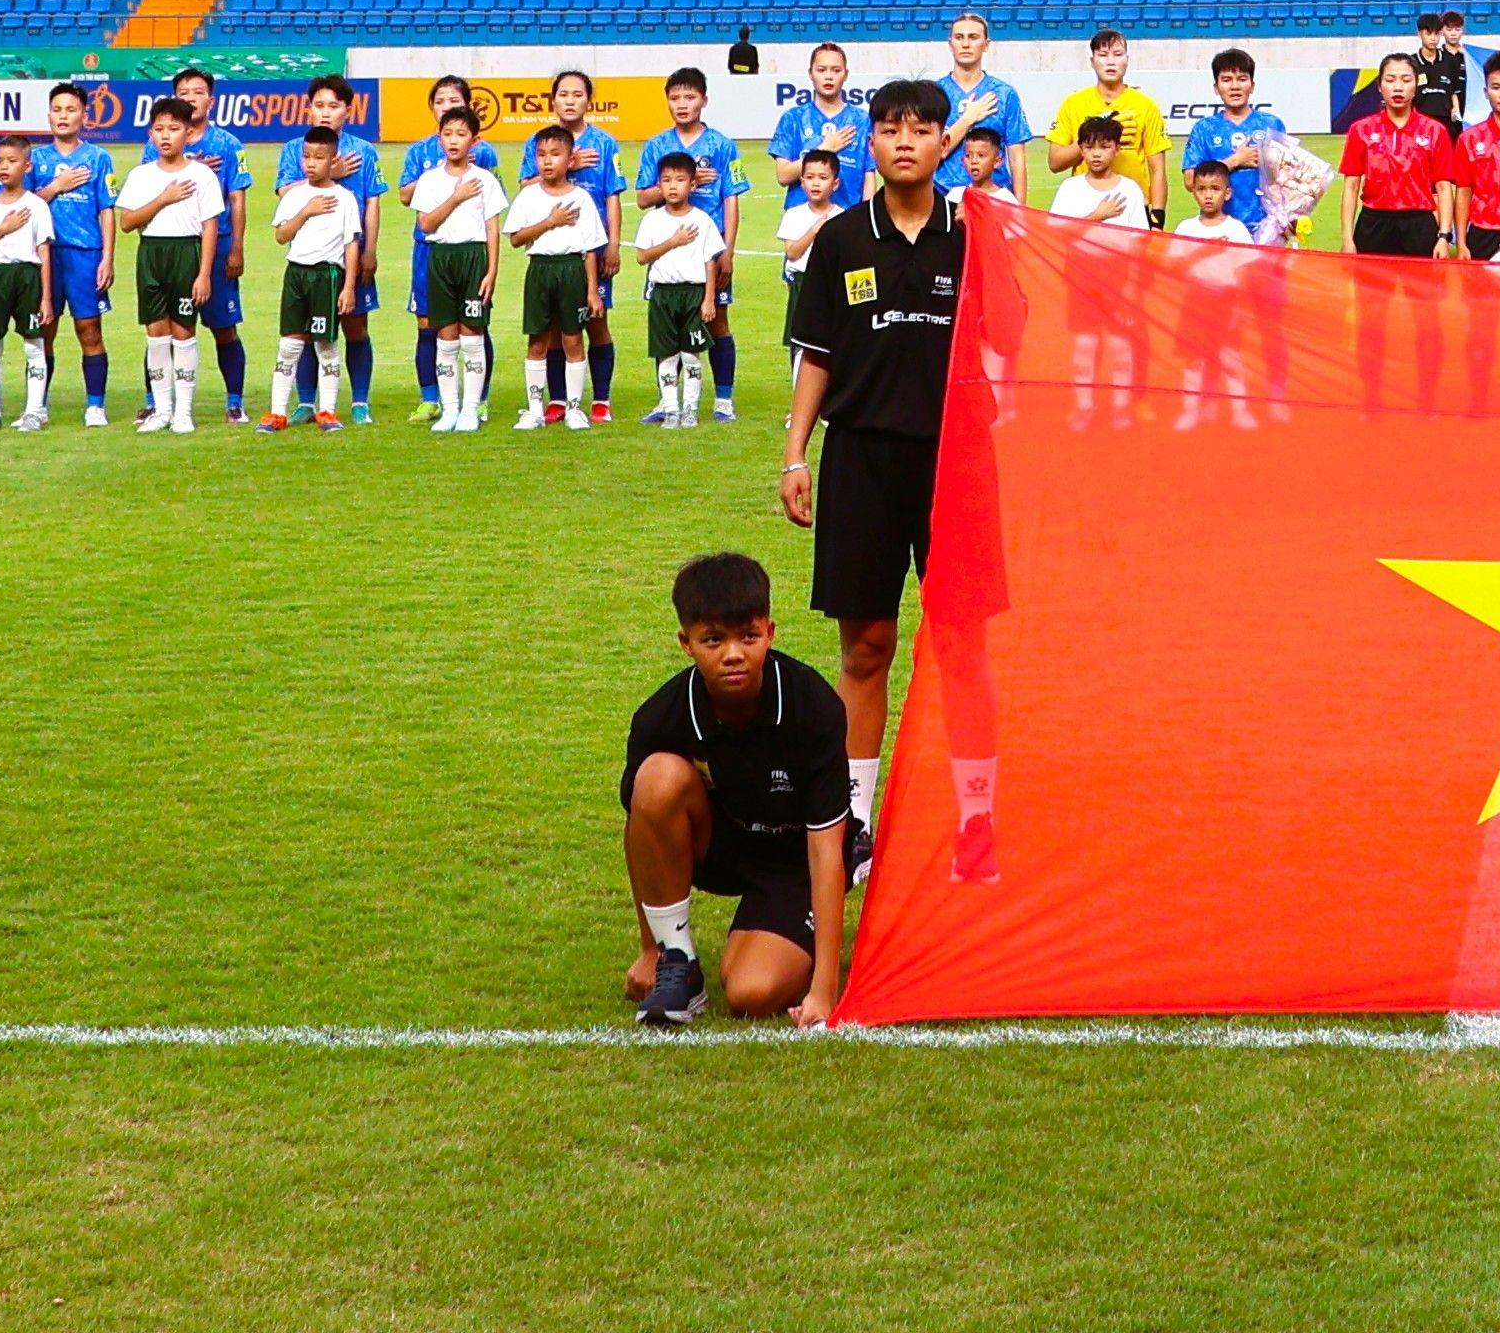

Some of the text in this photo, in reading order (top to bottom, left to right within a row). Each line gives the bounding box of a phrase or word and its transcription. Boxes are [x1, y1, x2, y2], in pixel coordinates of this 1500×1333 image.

[935, 275, 953, 285] FIFA
[850, 288, 874, 300] TSB
[892, 312, 951, 325] ELECTRIC
[771, 770, 789, 780] FIFA
